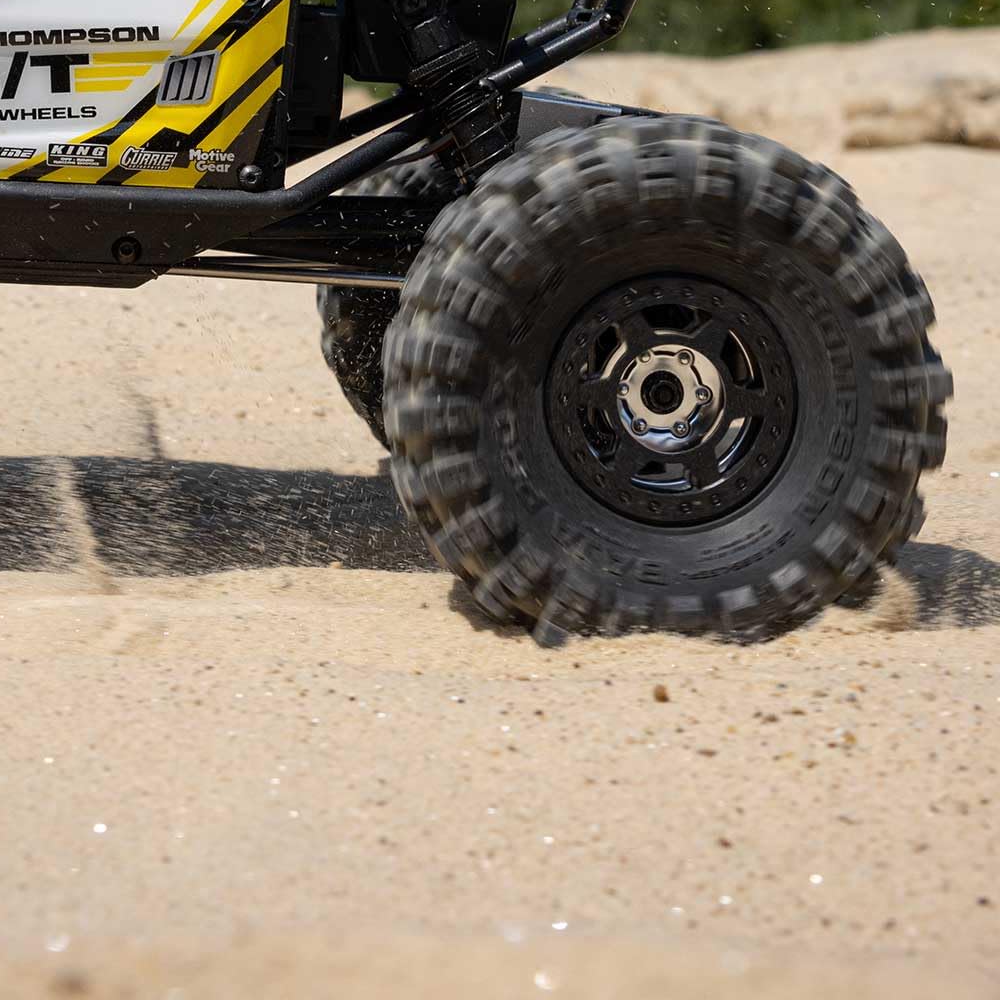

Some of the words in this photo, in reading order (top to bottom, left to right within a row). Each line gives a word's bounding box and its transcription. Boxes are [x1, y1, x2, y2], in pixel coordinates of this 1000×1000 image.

[50, 144, 106, 157] KING
[188, 148, 235, 162] Motive
[196, 160, 231, 173] Gear
